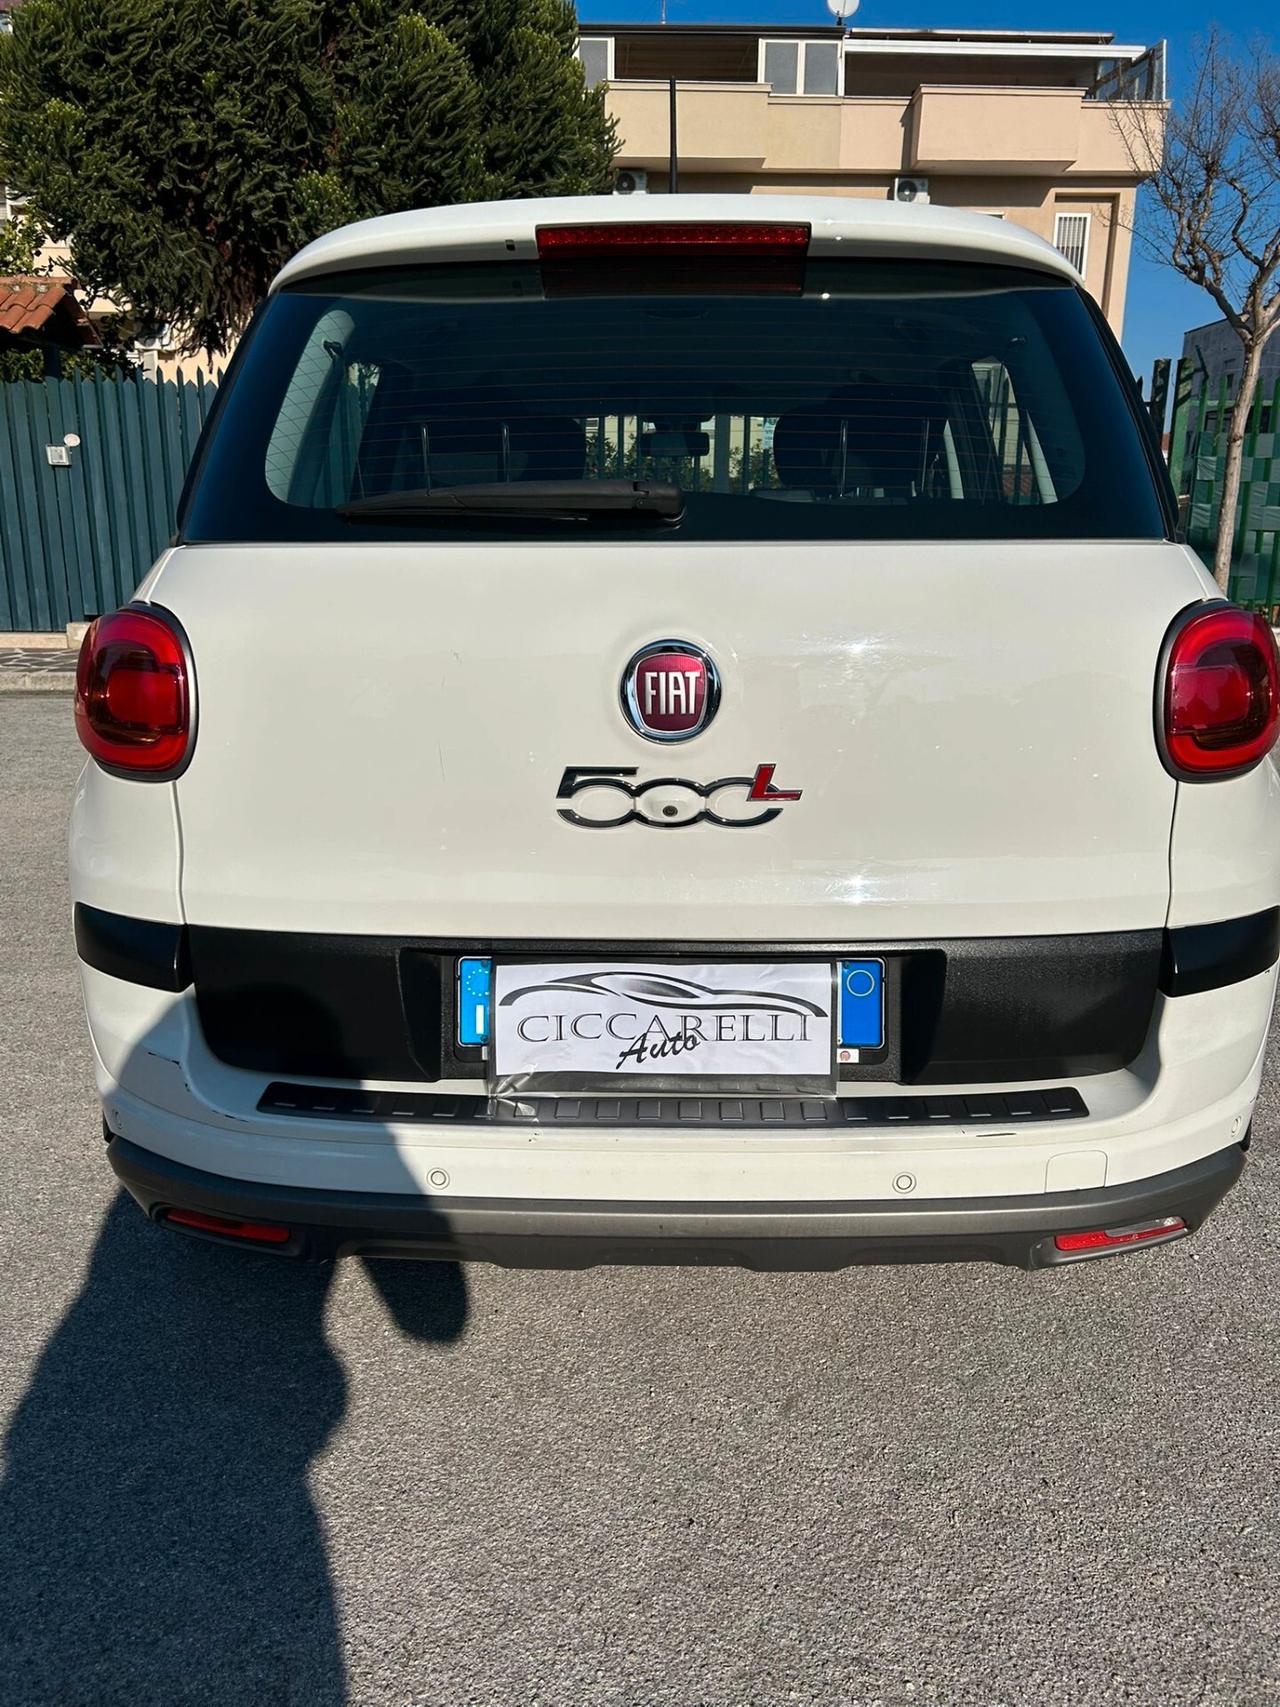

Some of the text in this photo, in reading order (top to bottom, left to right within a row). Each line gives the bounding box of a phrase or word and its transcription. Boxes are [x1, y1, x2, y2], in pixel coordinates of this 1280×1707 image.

[645, 671, 701, 715] FIAT
[516, 1013, 813, 1042] CICCARELLI
[616, 1031, 701, 1070] Auto
